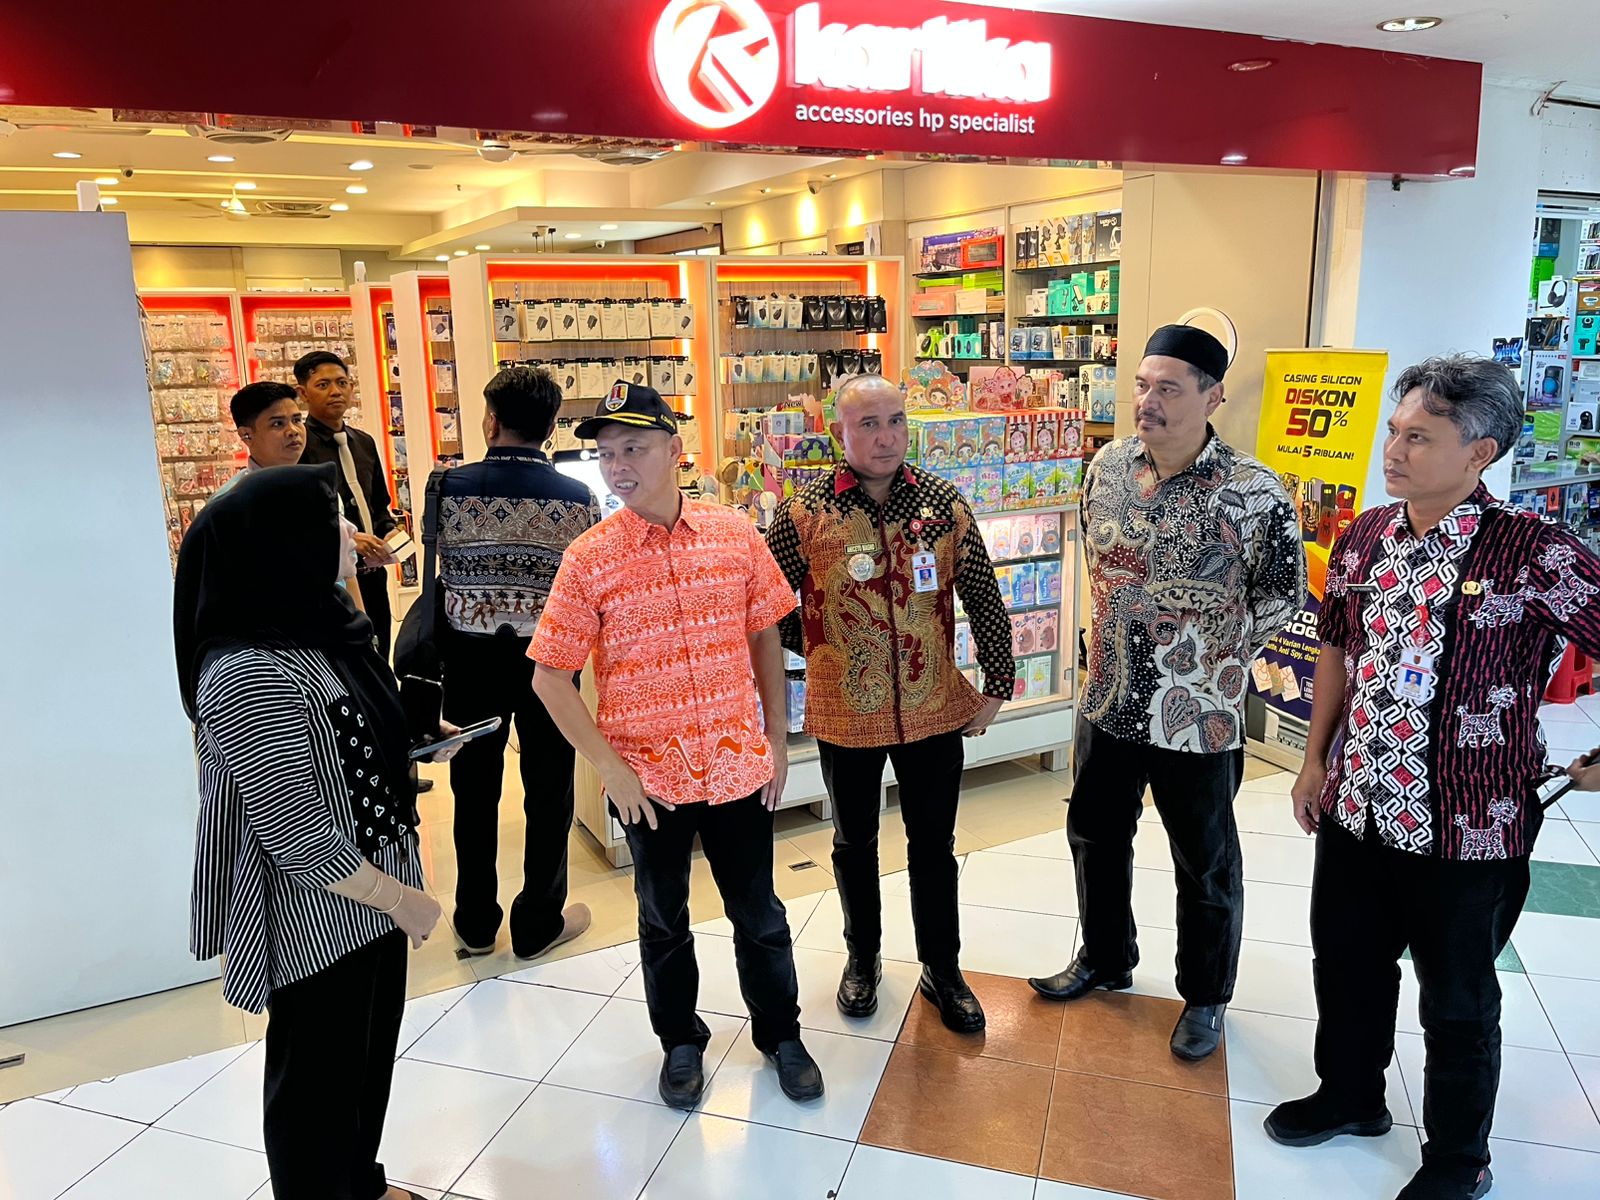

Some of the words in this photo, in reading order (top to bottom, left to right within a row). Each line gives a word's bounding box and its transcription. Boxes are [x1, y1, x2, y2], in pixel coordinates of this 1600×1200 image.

[795, 103, 913, 127] accessories
[919, 107, 944, 132] hp
[950, 112, 1035, 134] specialist
[1283, 374, 1318, 384] CASING
[1320, 375, 1362, 386] SILICON
[1285, 388, 1357, 408] DISKON
[1285, 407, 1349, 438] 50%
[1277, 445, 1302, 454] MULAI
[1302, 445, 1313, 458] 5
[1313, 448, 1355, 461] RIBUAN!
[1278, 646, 1290, 655] Anti
[1290, 649, 1303, 660] Spy,
[1304, 653, 1315, 662] dan
[1282, 637, 1301, 649] Varian
[1302, 643, 1321, 655] Lengka
